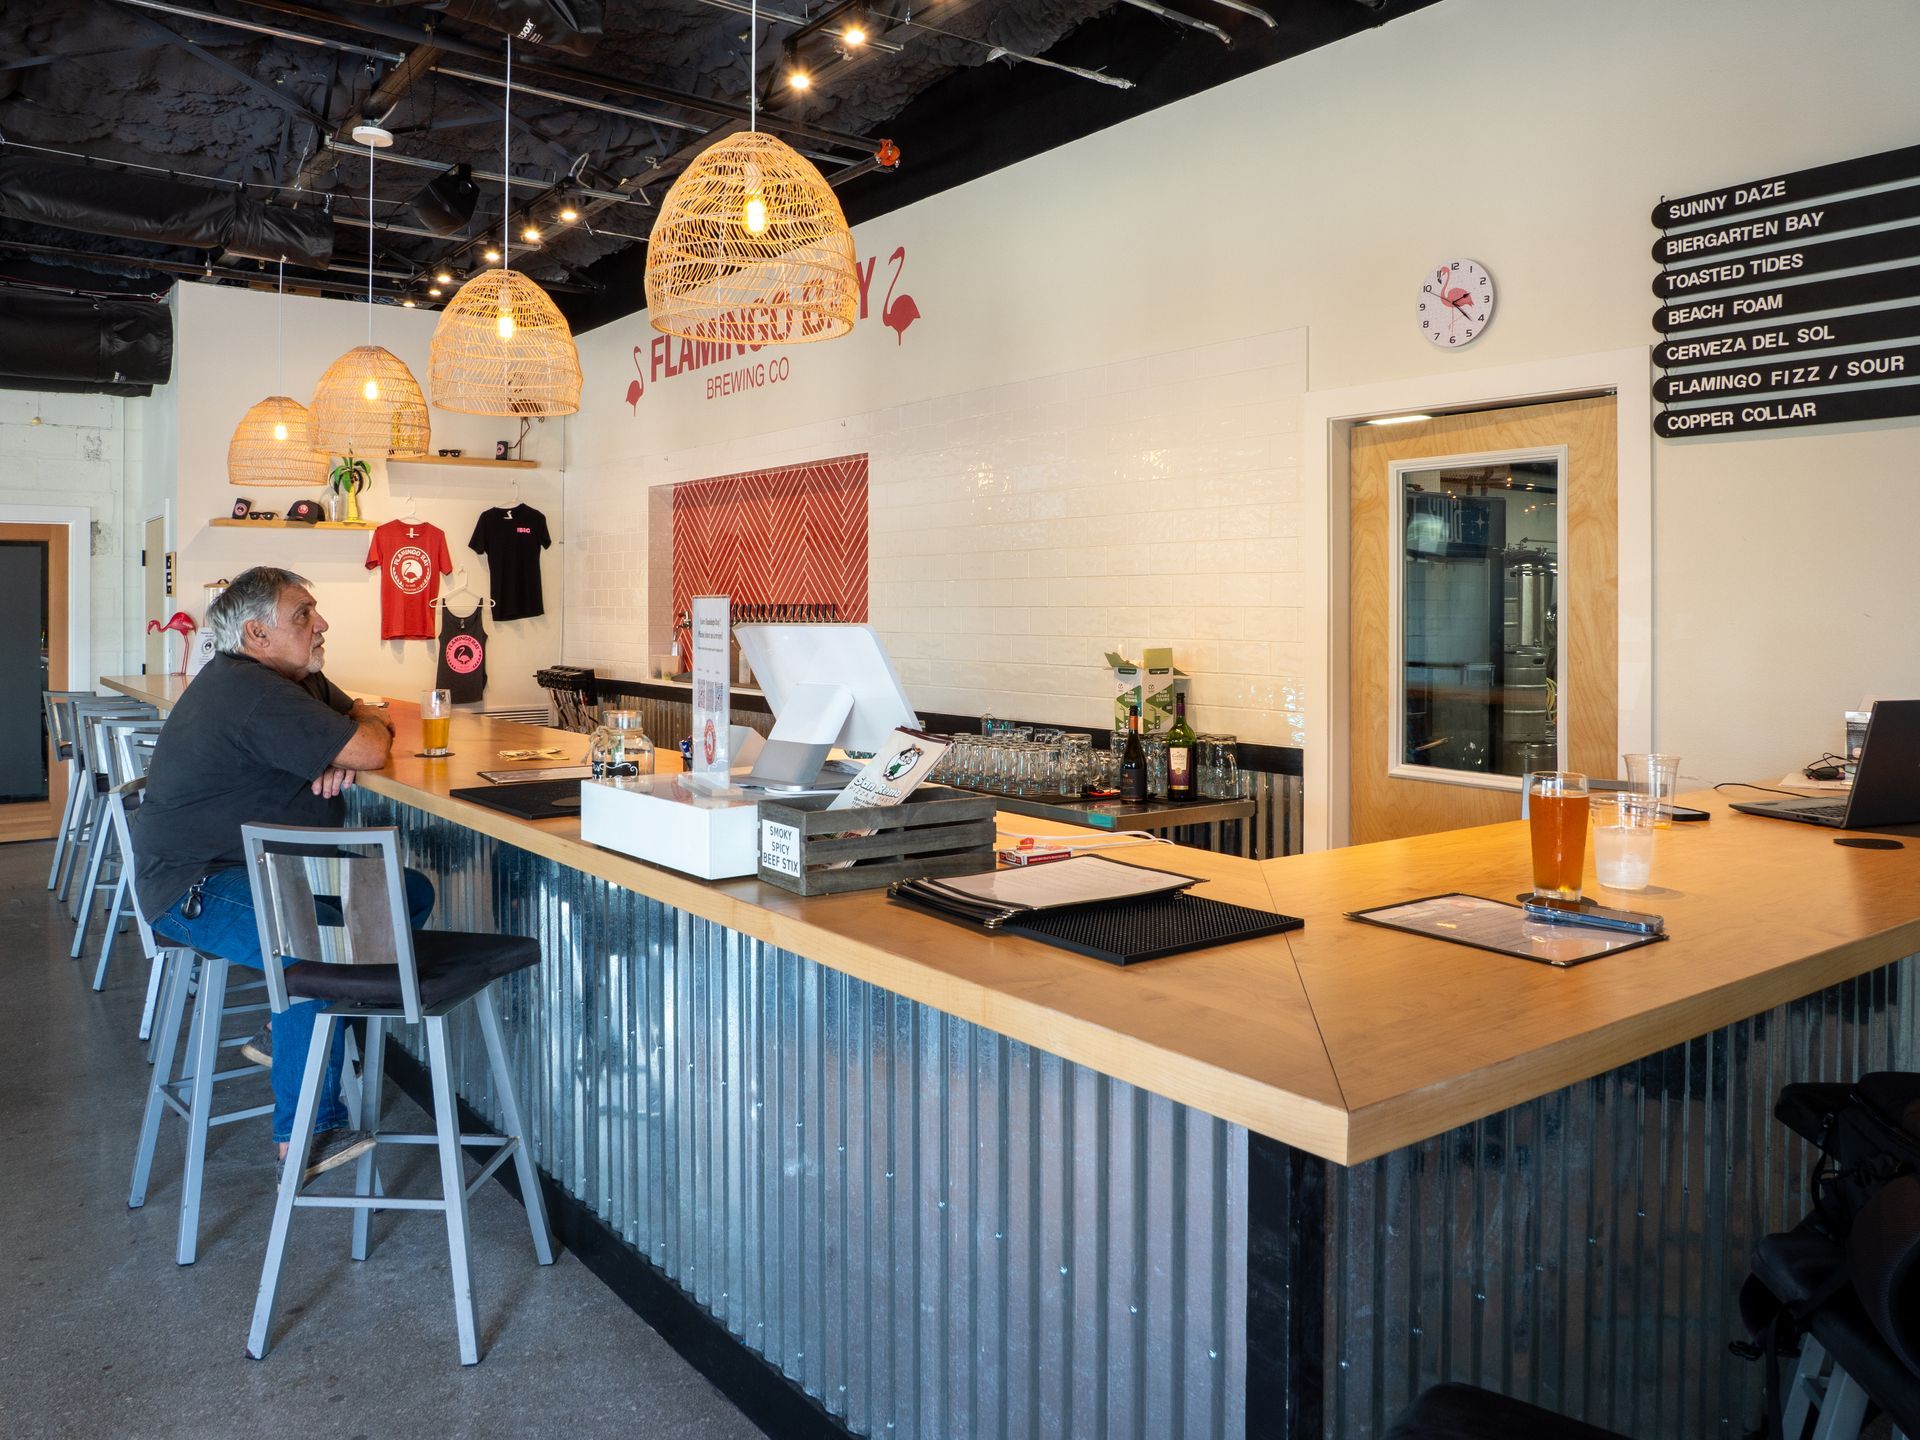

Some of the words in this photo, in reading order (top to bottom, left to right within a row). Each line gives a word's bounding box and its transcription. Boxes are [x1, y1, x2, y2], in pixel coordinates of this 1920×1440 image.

[1669, 195, 1727, 219] SUNNY
[1735, 181, 1786, 206] DAZE
[1666, 221, 1778, 255] BIERGARTEN
[1786, 212, 1824, 231] BAY
[1451, 262, 1460, 271] 12
[1666, 264, 1744, 290] TOASTED
[1750, 253, 1803, 275] TIDES
[1423, 284, 1432, 292] 10
[1479, 277, 1486, 285] 2
[1419, 303, 1426, 311] 9
[1483, 295, 1490, 303] 3
[1668, 304, 1723, 325] BEACH
[1733, 294, 1783, 316] FOAM
[1422, 320, 1429, 328] 8
[1477, 314, 1485, 322] 4
[1434, 332, 1440, 340] 7
[1449, 336, 1456, 344] 6
[1465, 329, 1473, 337] 5
[1666, 337, 1746, 360] CERVEZA
[1752, 331, 1789, 350] DEL
[1797, 325, 1835, 344] SOL
[706, 364, 765, 400] BREWING
[769, 356, 790, 383] CO
[1668, 372, 1761, 396] FLAMINGO
[1771, 366, 1820, 385] FIZZ
[1847, 356, 1905, 377] SOUR
[1667, 411, 1734, 430] COPPER
[1742, 402, 1816, 422] COLLAR
[394, 549, 421, 566] FLAMINGO
[853, 777, 876, 792] San
[875, 783, 902, 798] Remo
[769, 825, 792, 841] SMOKY
[771, 841, 790, 856] SPICY
[763, 852, 780, 867] BEEF
[782, 857, 799, 874] STIX
